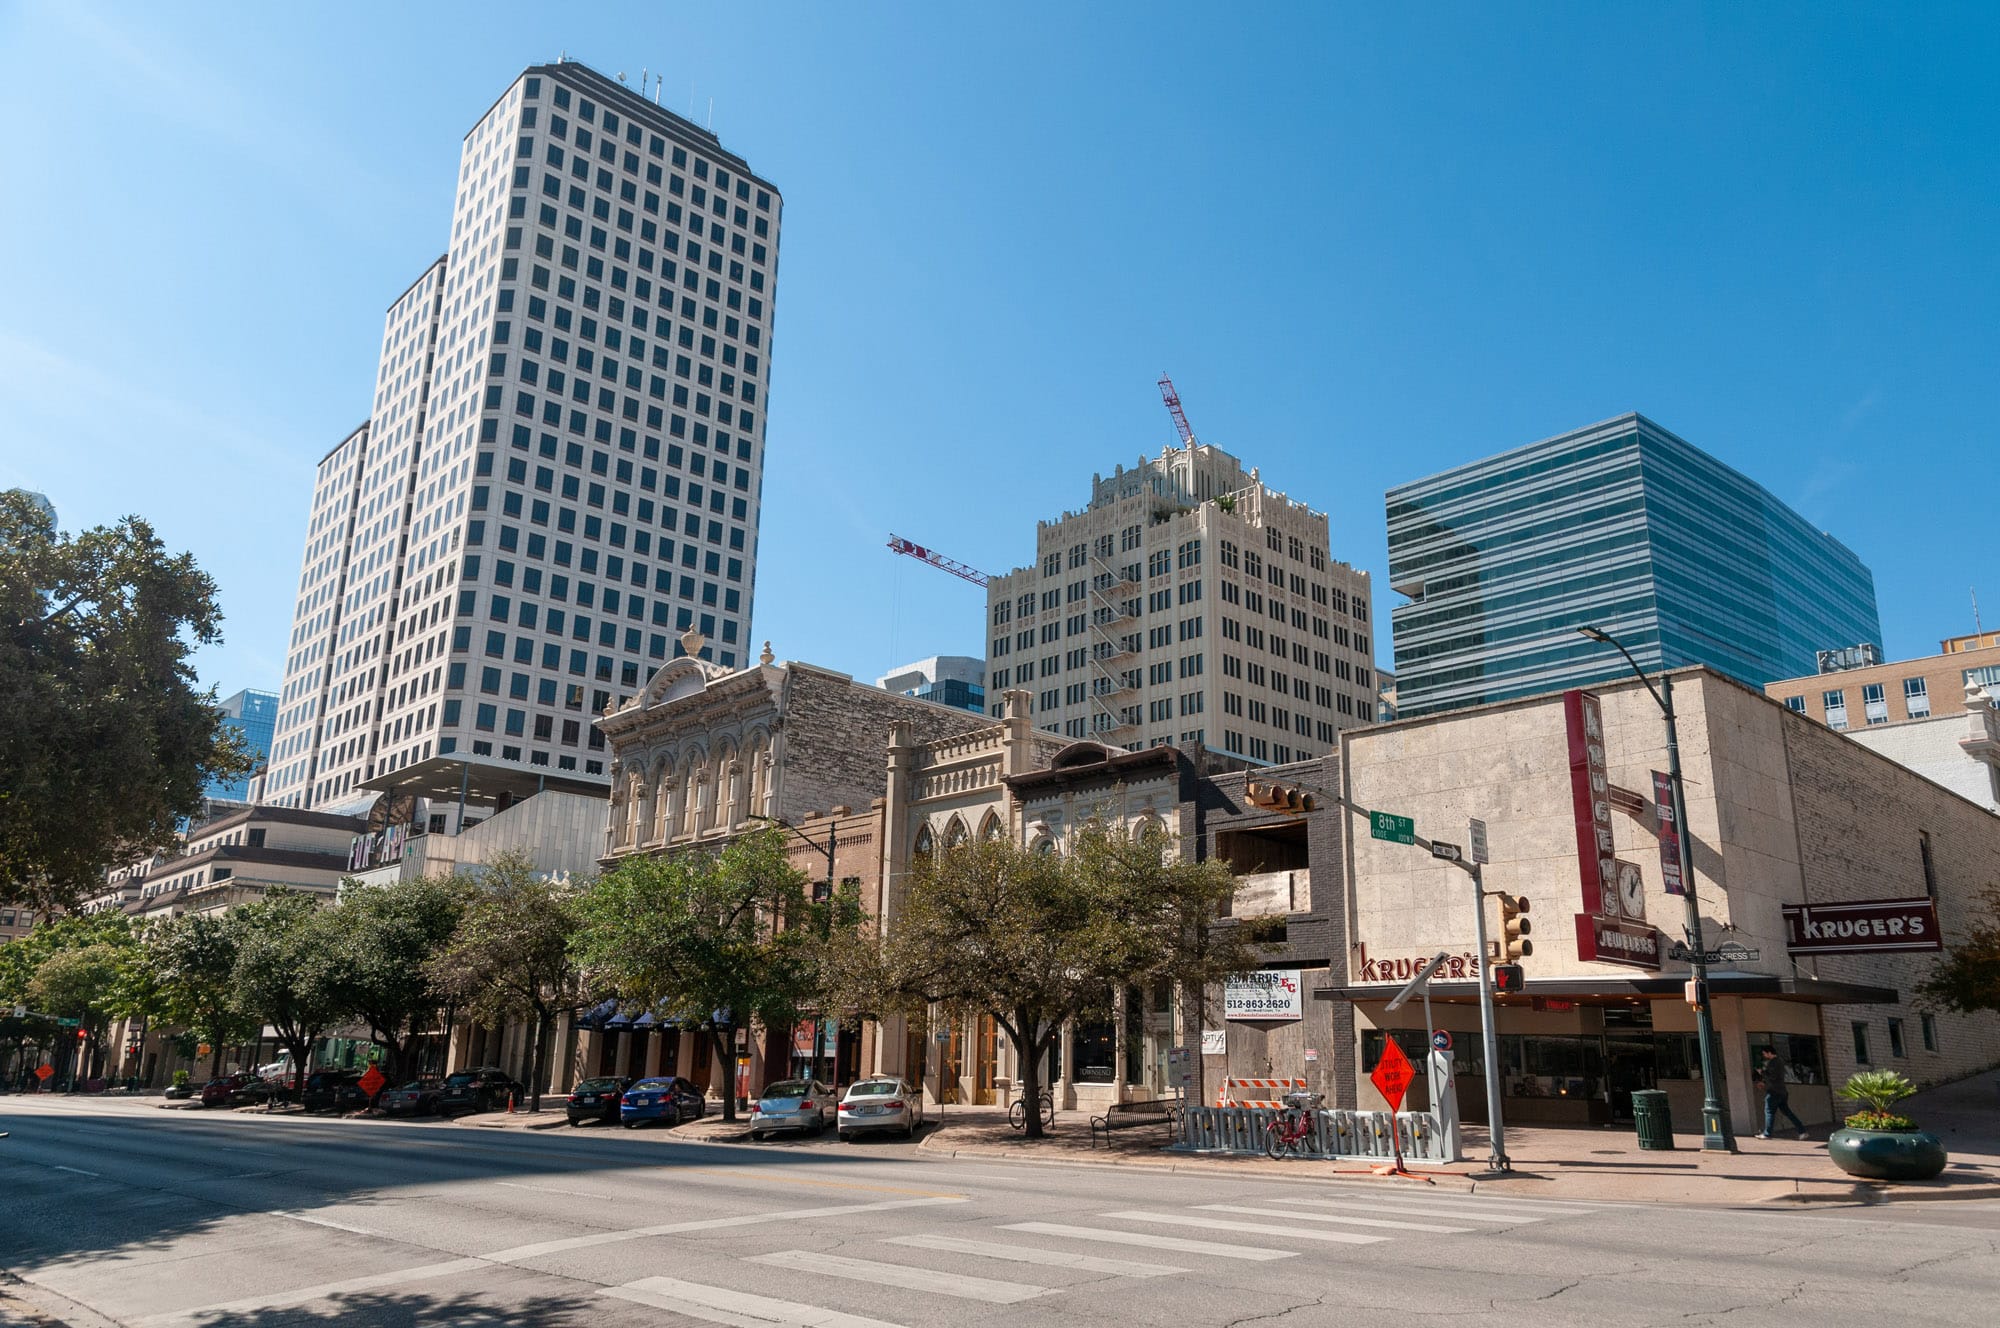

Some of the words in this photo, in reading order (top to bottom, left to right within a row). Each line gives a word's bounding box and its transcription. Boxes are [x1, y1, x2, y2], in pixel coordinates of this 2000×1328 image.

[1584, 702, 1617, 917] KRUGER'S
[1378, 814, 1395, 831] 8th
[1398, 818, 1406, 827] ST
[347, 832, 374, 872] FOR
[1803, 908, 1925, 939] KRUGER'S
[1599, 930, 1656, 955] JEWELERS
[1360, 942, 1481, 982] KRUGER'S
[1706, 952, 1748, 961] CONGRESS
[1384, 1071, 1401, 1081] WORK
[1385, 1083, 1403, 1094] AHEAD
